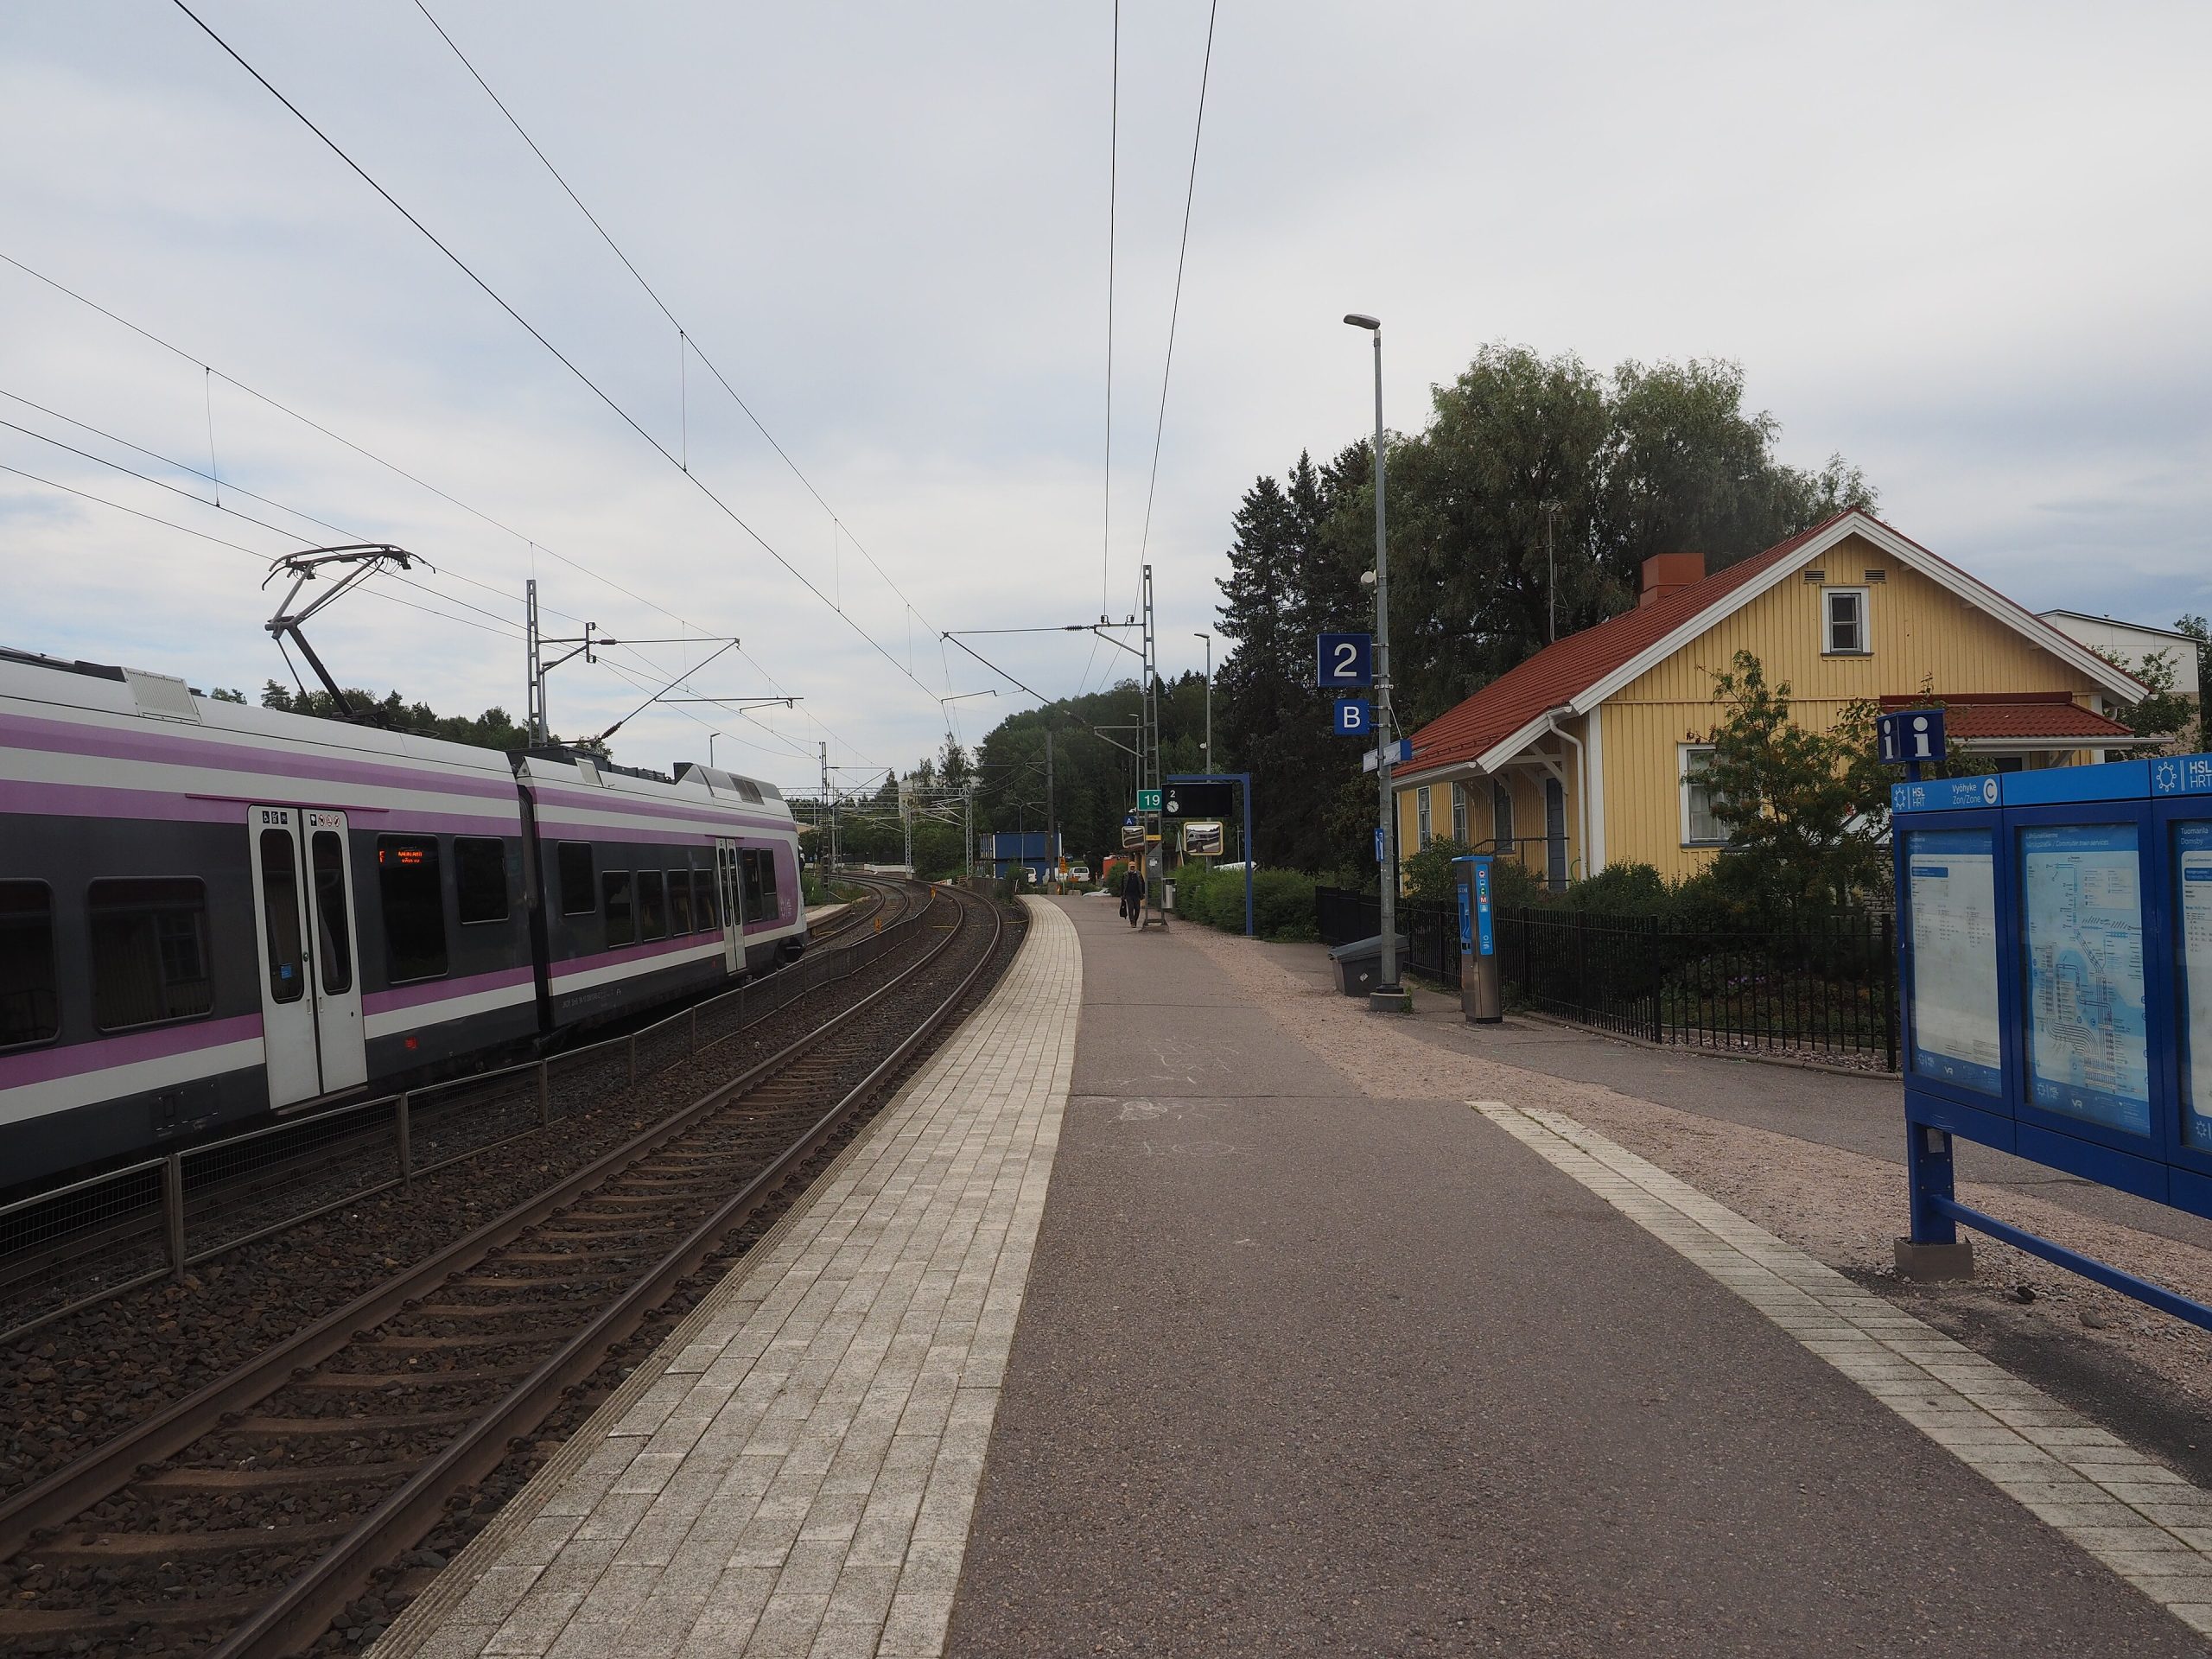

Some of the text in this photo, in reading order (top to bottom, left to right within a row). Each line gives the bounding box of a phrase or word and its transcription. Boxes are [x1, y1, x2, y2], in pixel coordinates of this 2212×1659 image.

[1333, 643, 1357, 677] 2
[1344, 706, 1361, 728] B
[2190, 760, 2212, 774] HSL
[2190, 774, 2212, 788] HRT
[1912, 787, 1925, 798] HSL
[1952, 783, 1977, 794] Vyöhyke
[1144, 794, 1160, 805] 19
[1912, 798, 1925, 807] HRT
[1953, 795, 1980, 804] Zon/Zone
